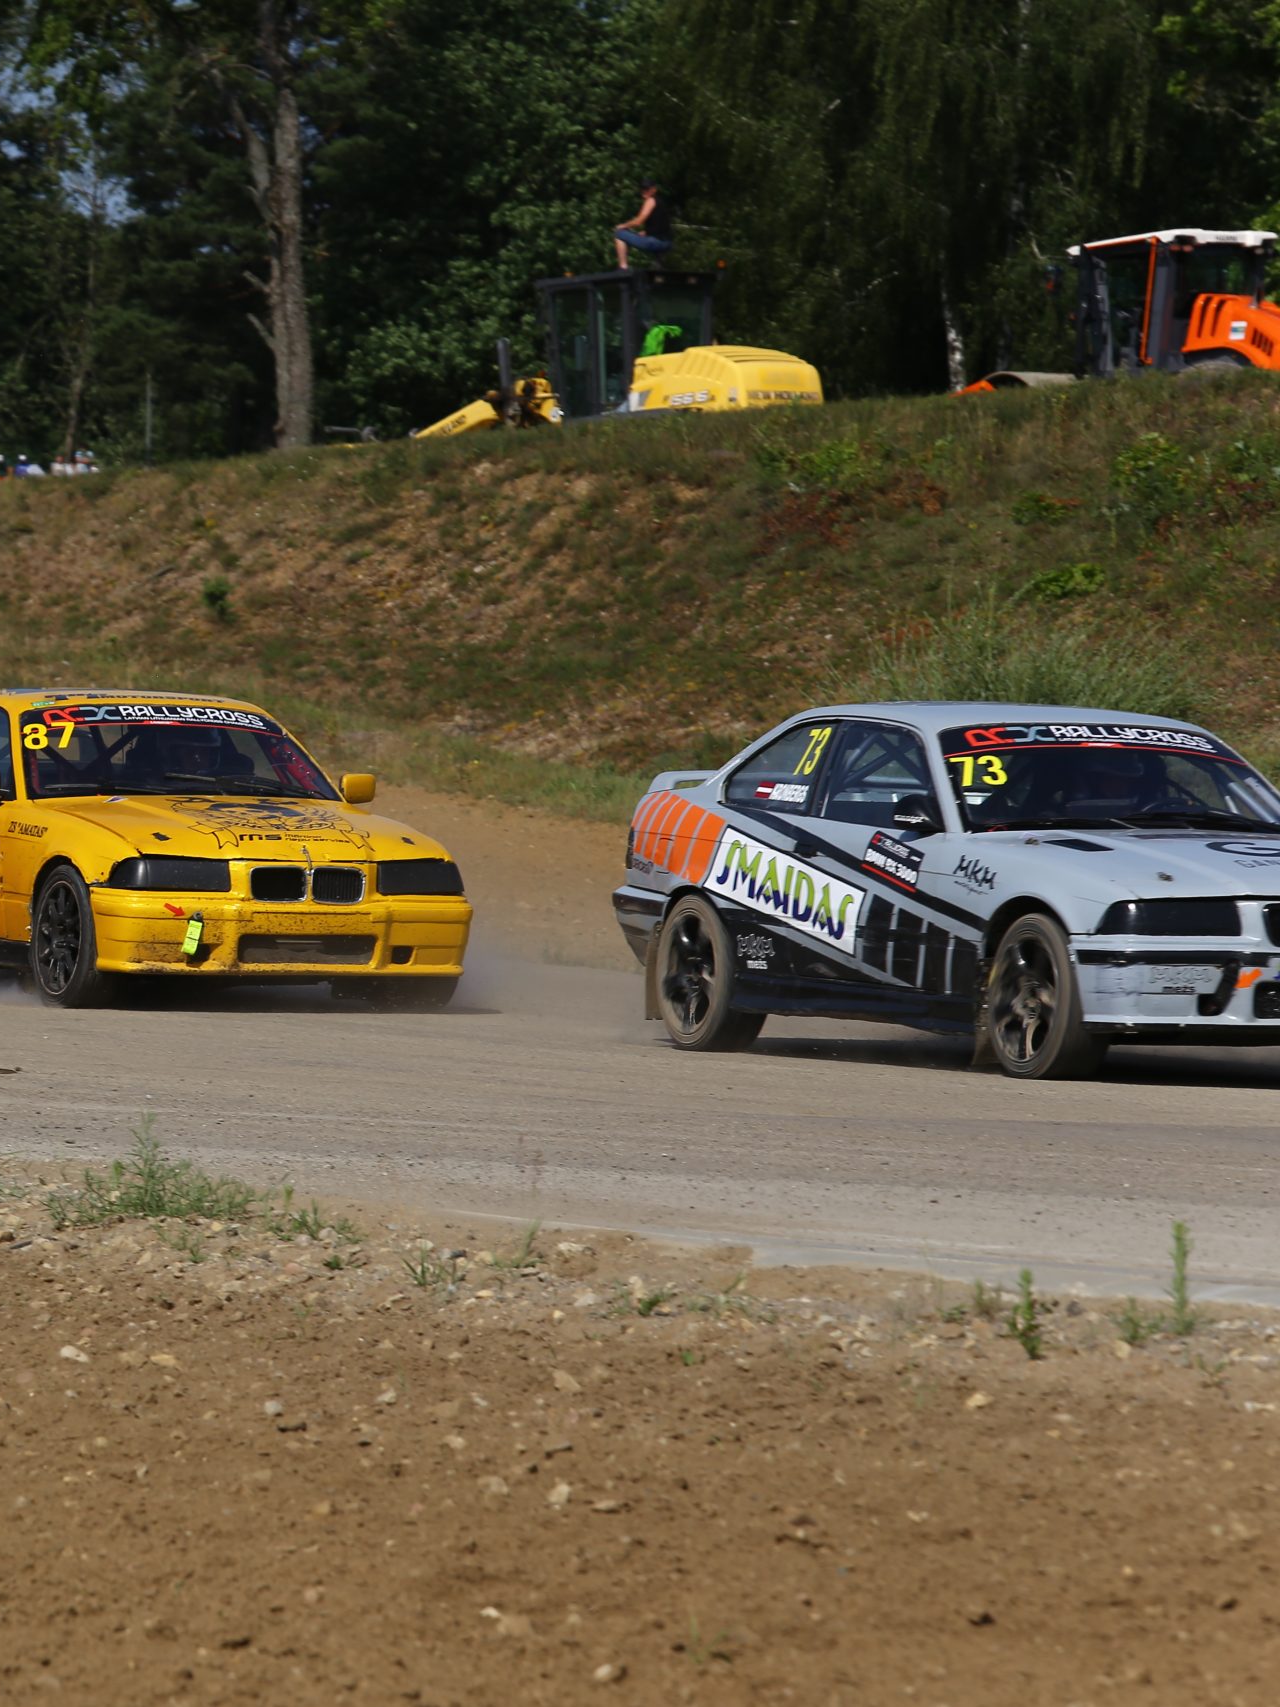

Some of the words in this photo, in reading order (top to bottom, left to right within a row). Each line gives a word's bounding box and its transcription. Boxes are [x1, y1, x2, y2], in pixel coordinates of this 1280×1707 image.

[118, 705, 264, 727] RALLYCROSS
[22, 721, 76, 750] 87
[1048, 725, 1214, 751] RALLYCROSS
[793, 727, 833, 776] 73
[949, 755, 1008, 787] 73
[716, 839, 855, 941] SMAIDAS
